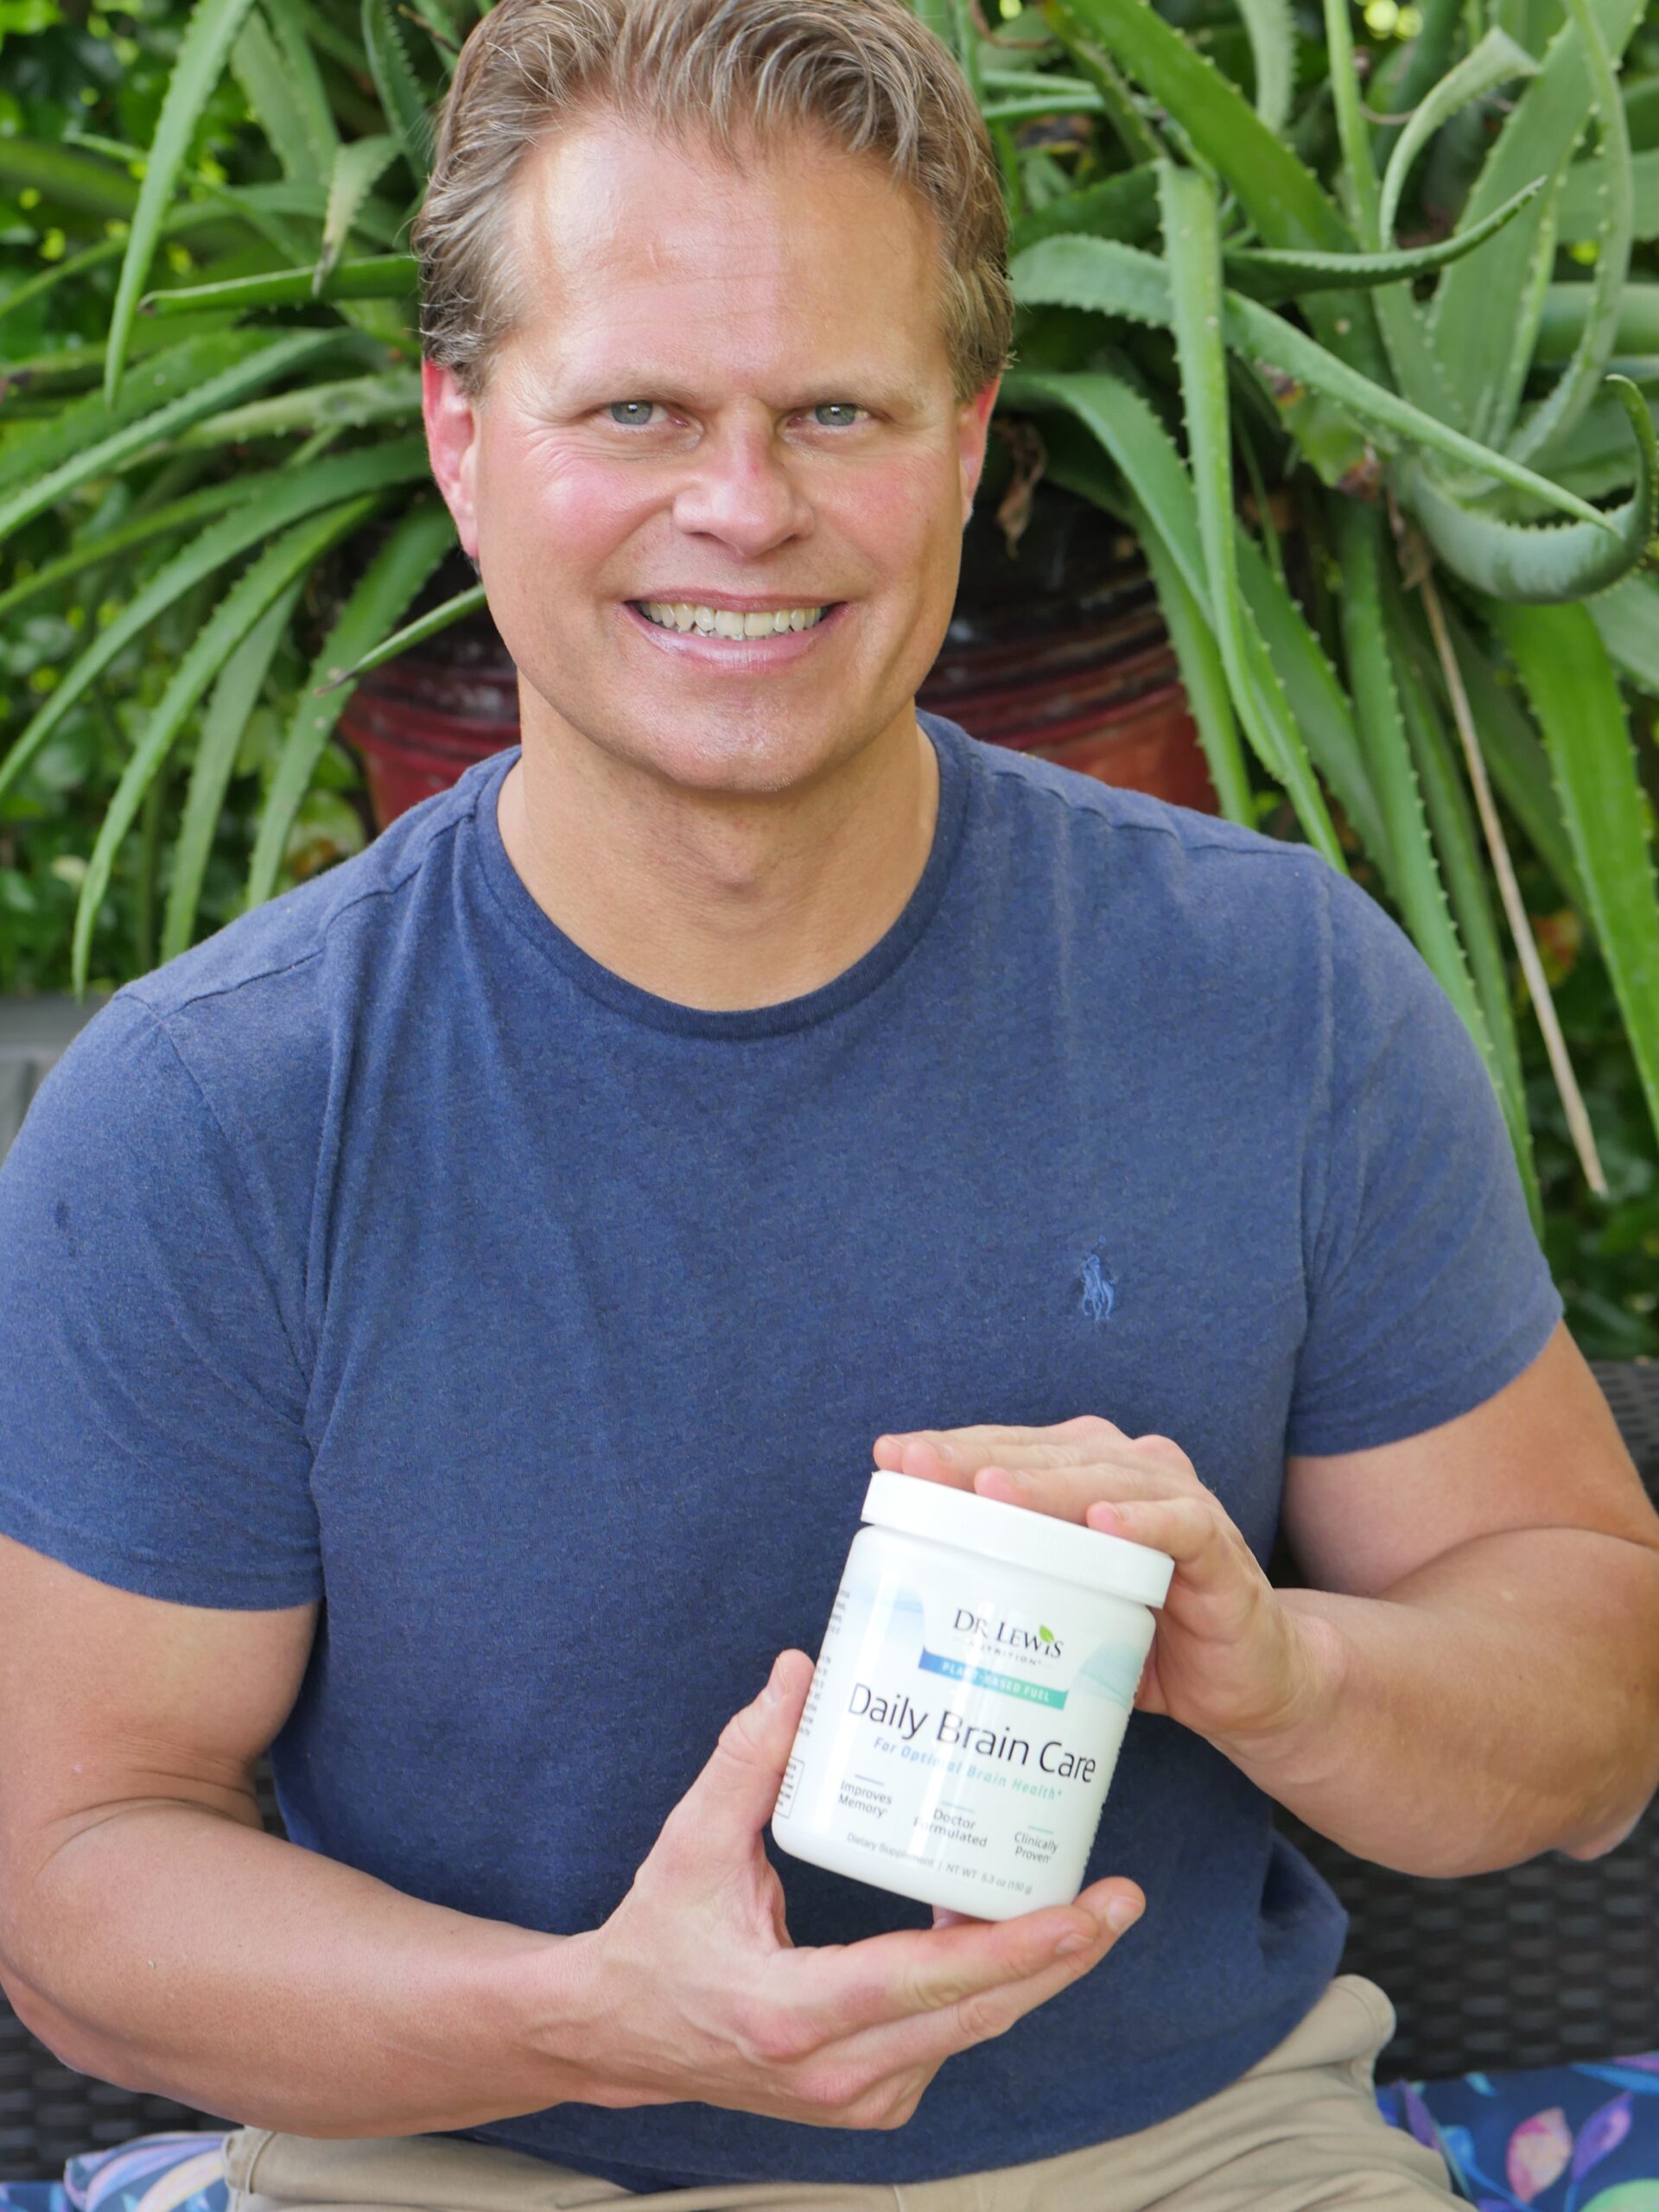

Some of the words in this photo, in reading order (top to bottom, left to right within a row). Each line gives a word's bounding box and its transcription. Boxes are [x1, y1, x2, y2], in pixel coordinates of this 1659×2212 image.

[1023, 1685, 1050, 1702] FUEL
[849, 1682, 929, 1740] Daily
[936, 1710, 1030, 1766] Brain
[1039, 1741, 1096, 1783] Care
[874, 1737, 895, 1753] For
[967, 1765, 1007, 1787] Brain
[840, 1780, 893, 1805] Improves
[933, 1808, 976, 1829] Doctor
[847, 1832, 877, 1853] Dietary
[946, 1863, 960, 1875] NT
[962, 1866, 978, 1878] WT
[1014, 1832, 1058, 1854] Clinically
